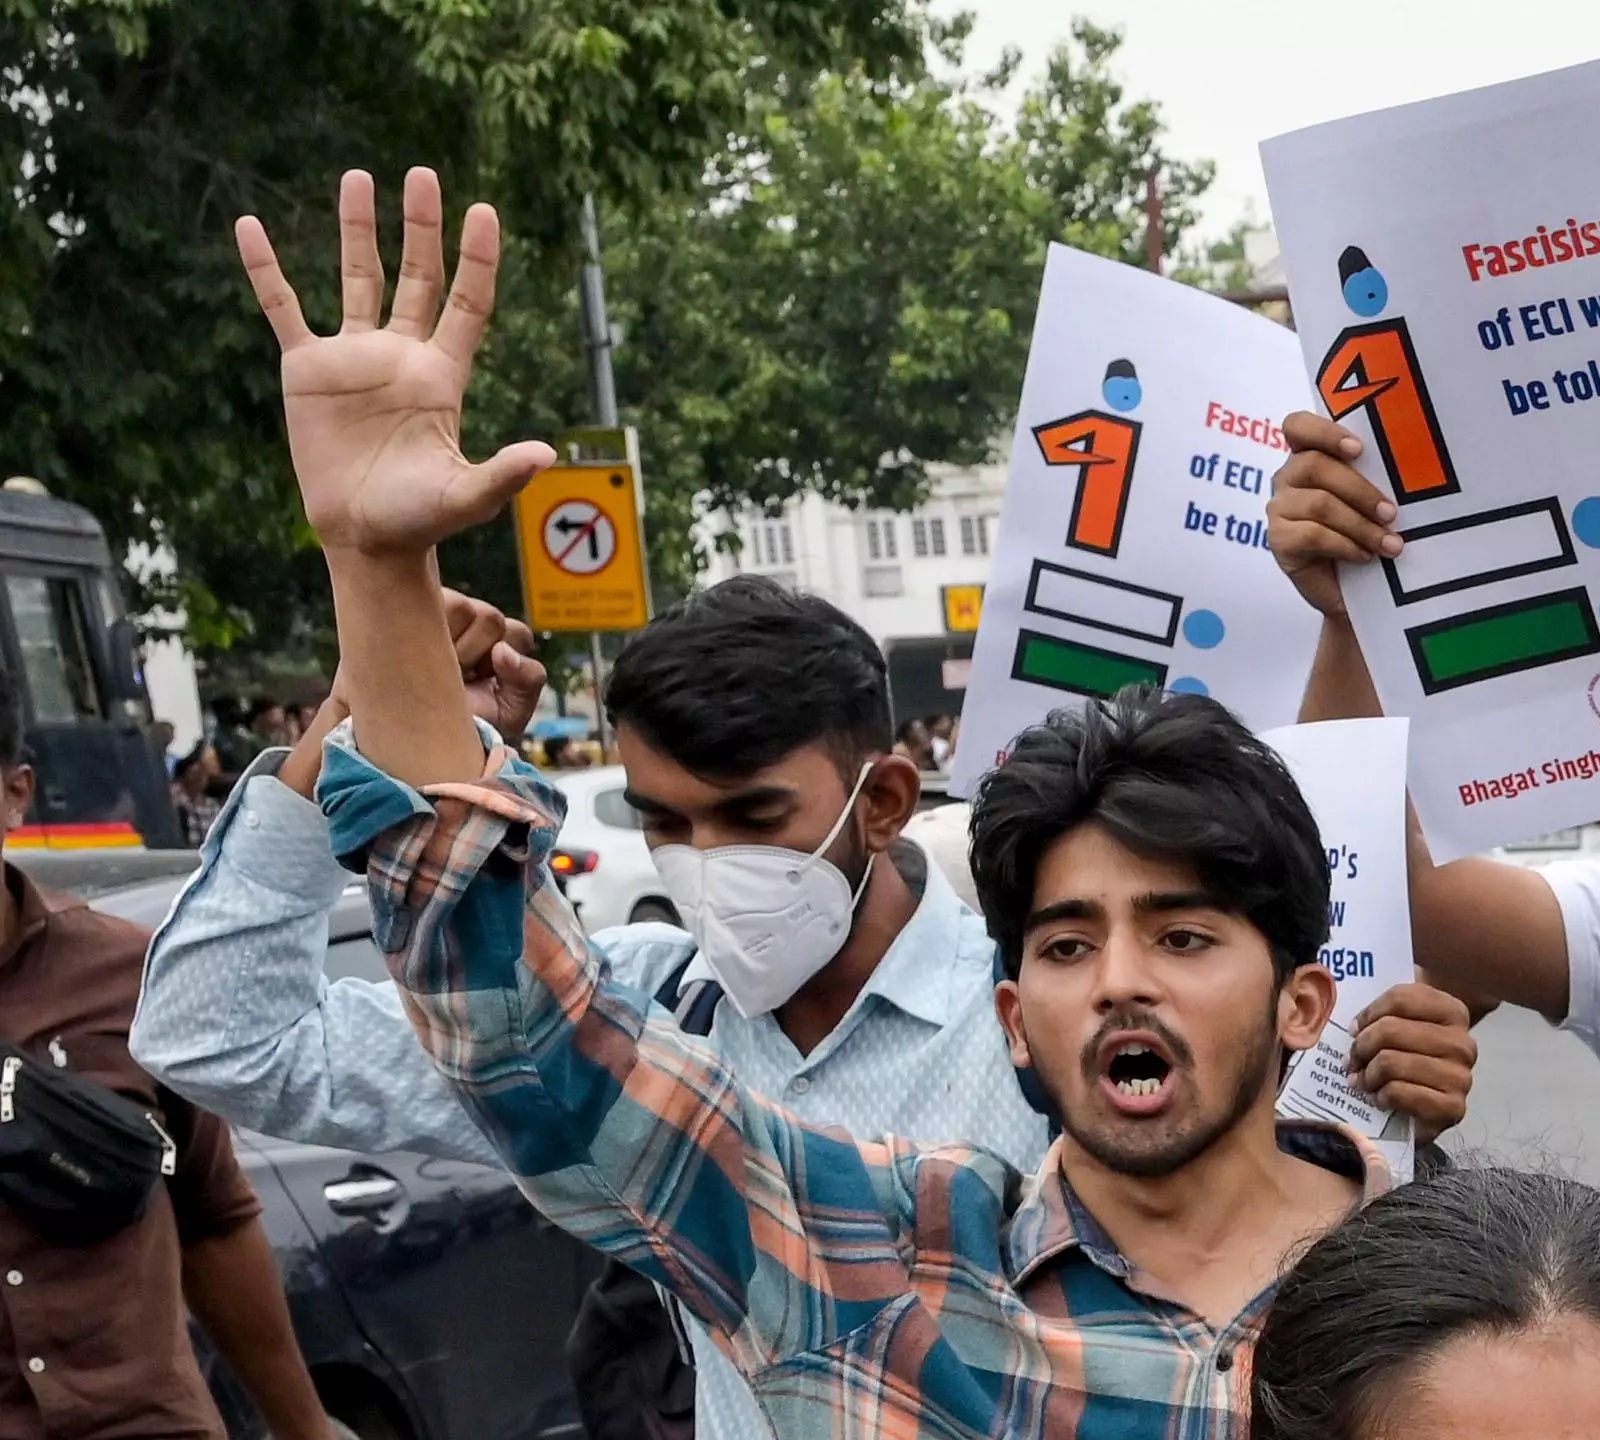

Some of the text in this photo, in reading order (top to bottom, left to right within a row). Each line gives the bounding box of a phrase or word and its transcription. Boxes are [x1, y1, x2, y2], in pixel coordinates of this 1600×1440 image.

[1477, 308, 1515, 351] of
[1520, 298, 1574, 342] ECI
[1502, 378, 1550, 416] be
[1205, 401, 1291, 453] Fascis
[1189, 454, 1221, 482] of
[1224, 461, 1262, 495] ECI
[1184, 501, 1218, 536] be
[1458, 766, 1540, 807] Bhagat
[1310, 1070, 1329, 1086] not
[1316, 1089, 1346, 1110] draft
